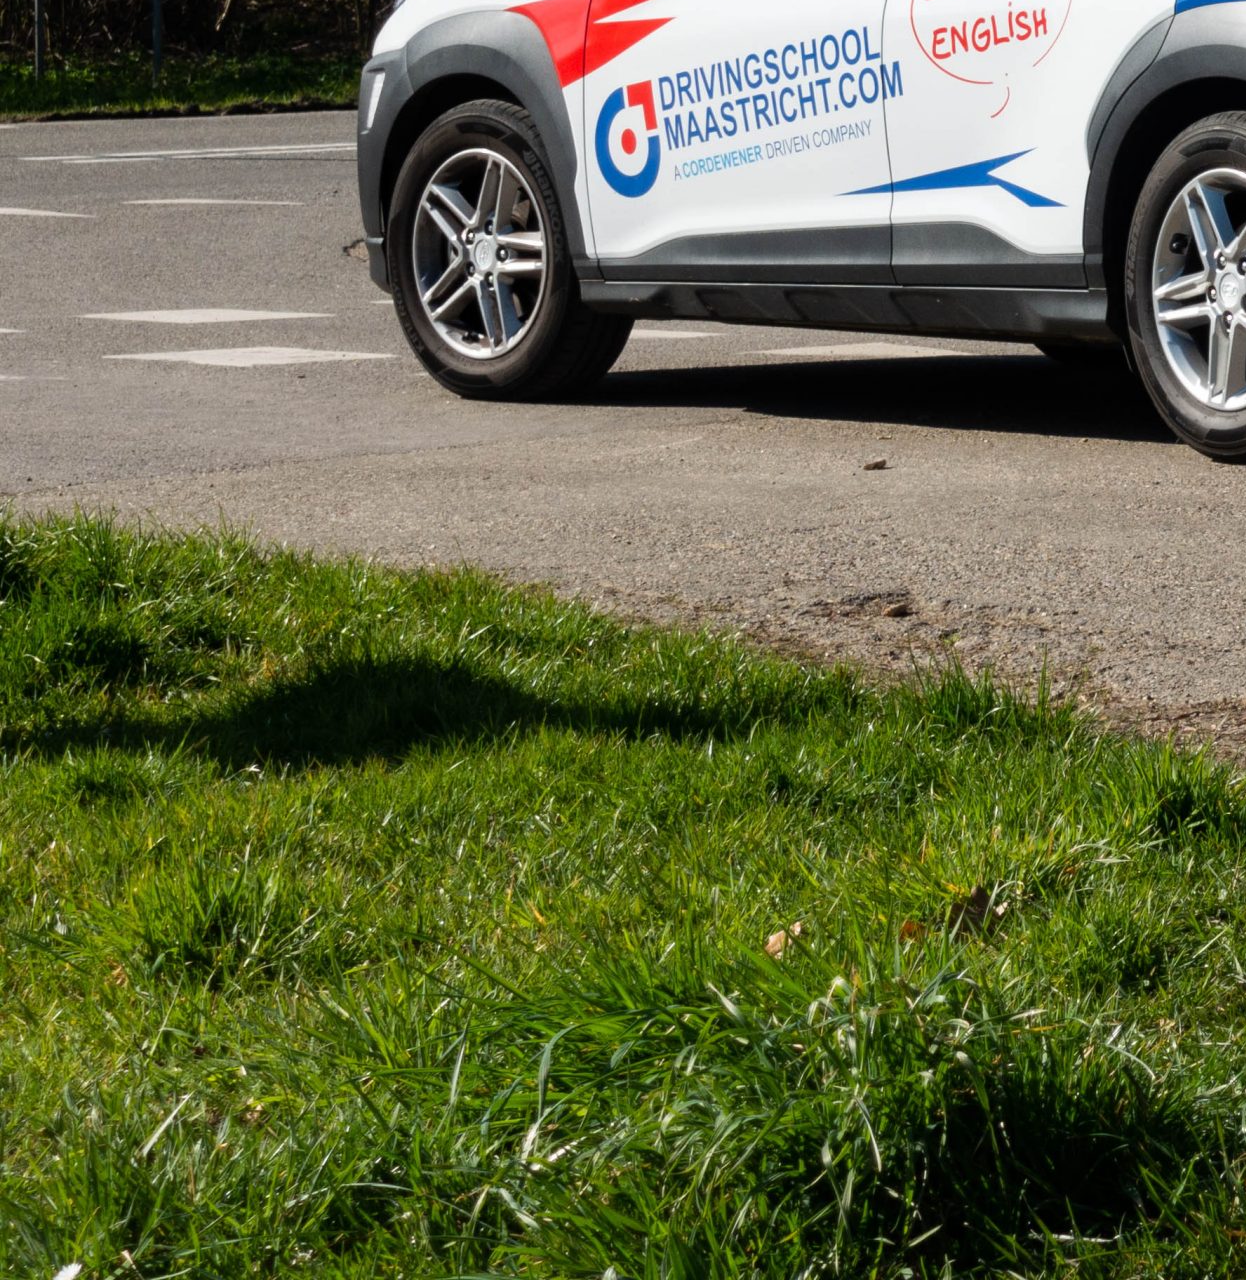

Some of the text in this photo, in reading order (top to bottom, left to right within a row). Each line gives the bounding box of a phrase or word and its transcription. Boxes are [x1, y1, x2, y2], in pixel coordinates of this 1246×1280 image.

[658, 26, 881, 111] DRIVINGSCHOOL
[663, 61, 904, 151] MAASTRICHT.COM
[674, 120, 872, 181] A CORDEWENER DRIVEN COMPANY
